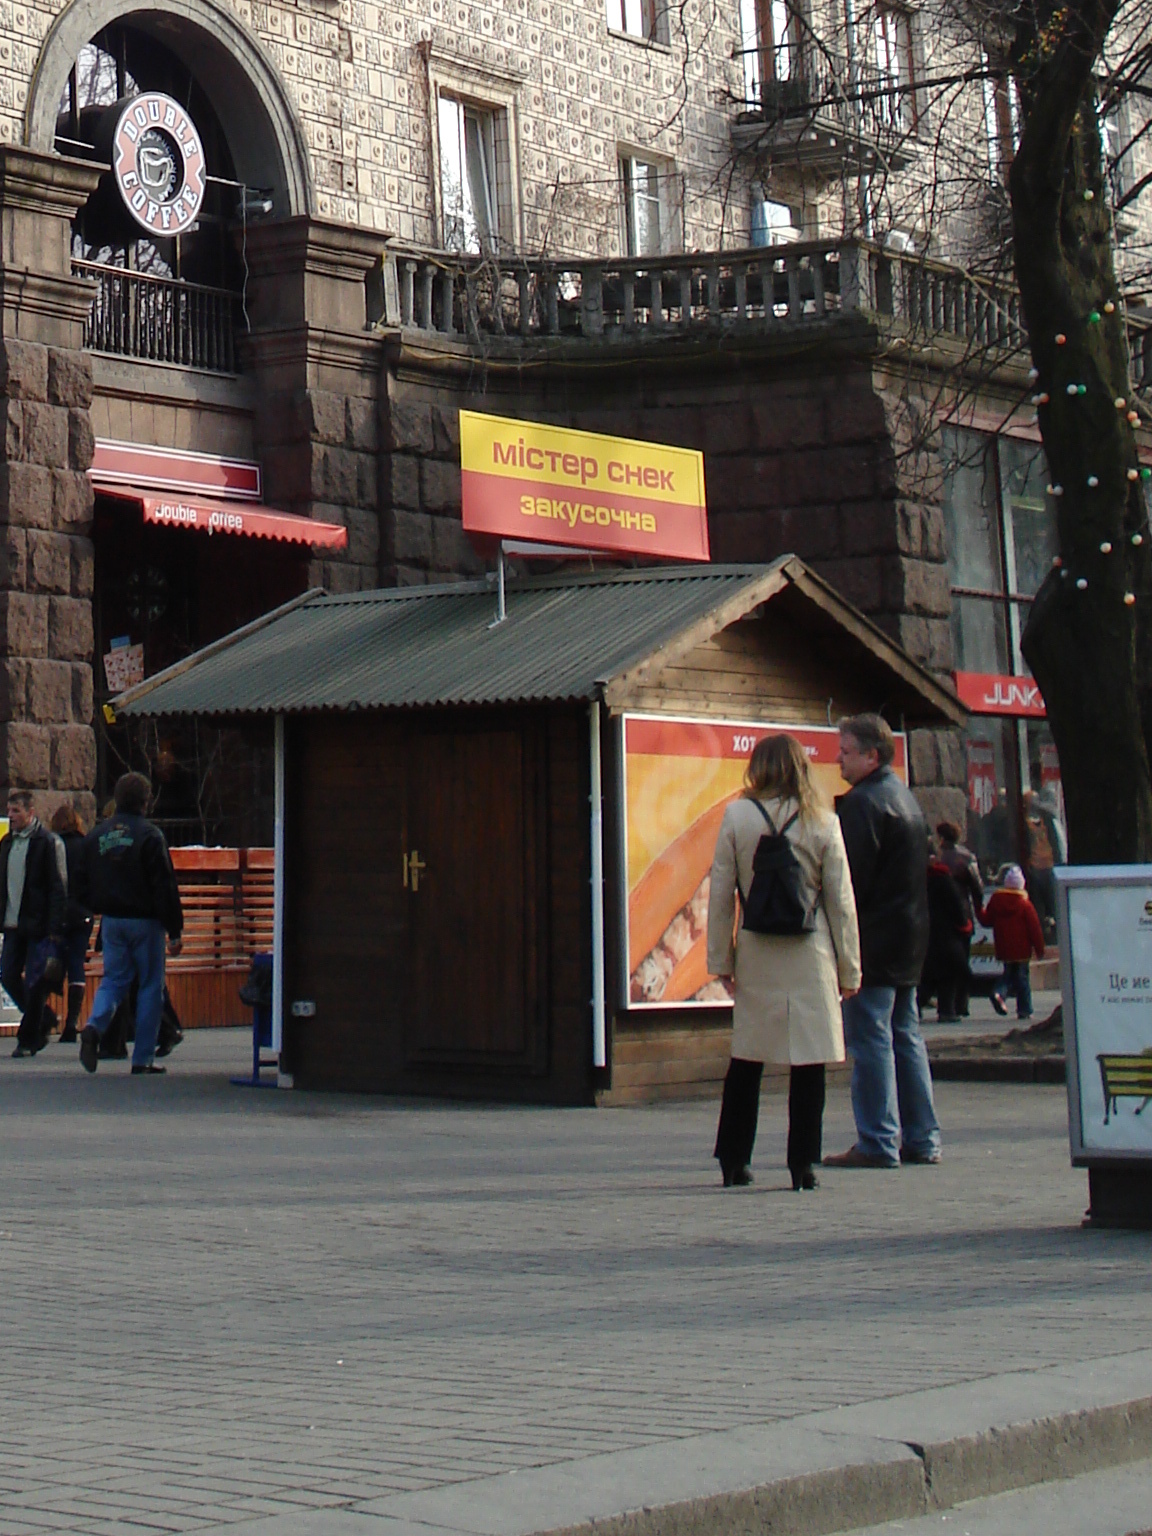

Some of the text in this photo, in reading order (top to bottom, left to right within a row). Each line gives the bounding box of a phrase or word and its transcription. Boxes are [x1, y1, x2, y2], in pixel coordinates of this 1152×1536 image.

[123, 100, 198, 158] DOUBLE
[122, 170, 198, 228] COFFEE
[492, 437, 676, 492] містер снек
[520, 495, 657, 533] закусочна
[1109, 973, 1128, 992] Це
